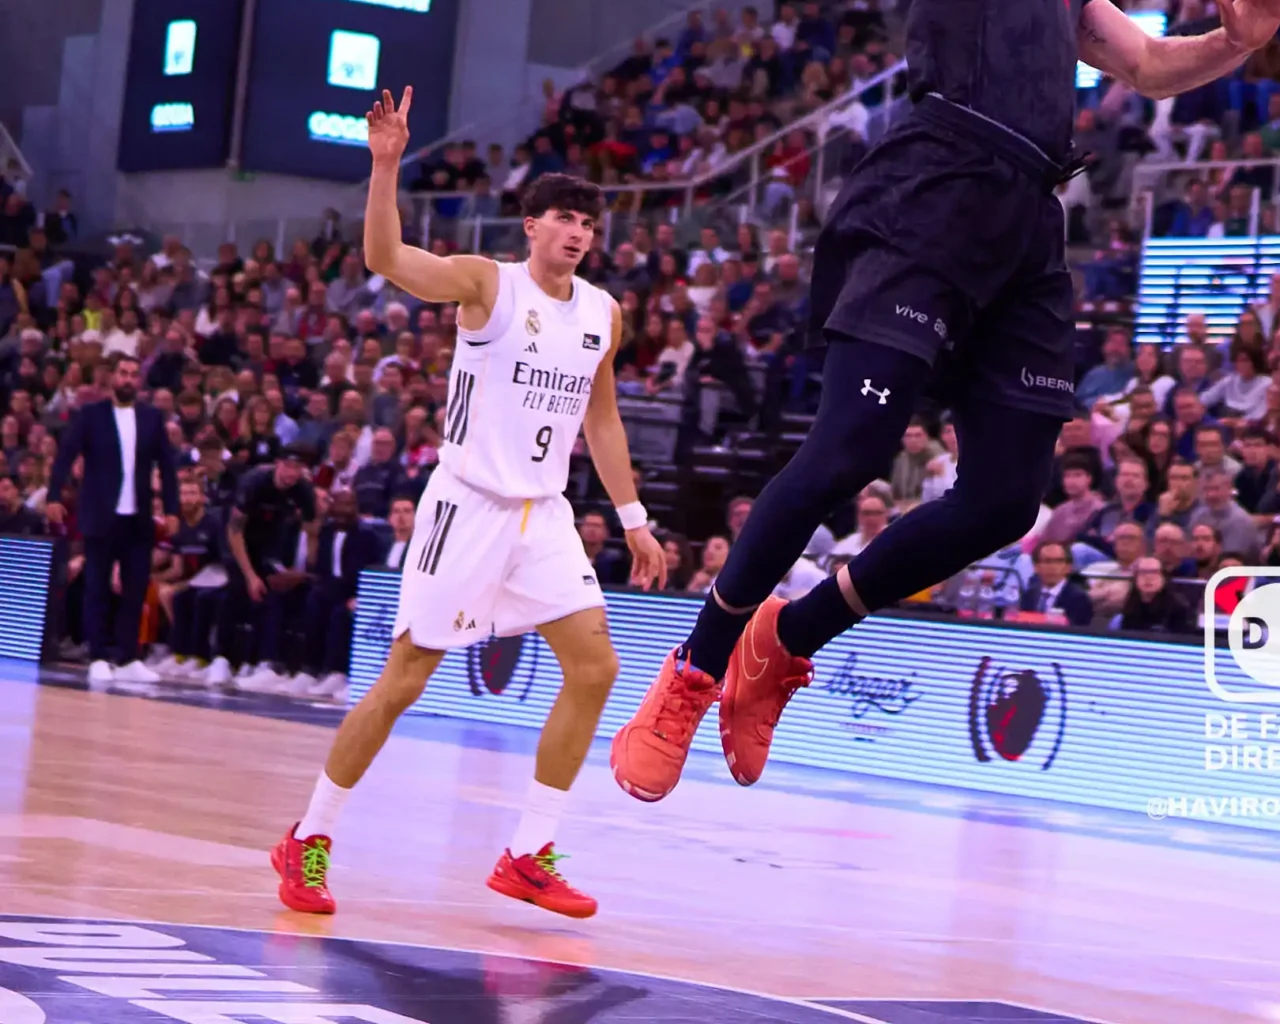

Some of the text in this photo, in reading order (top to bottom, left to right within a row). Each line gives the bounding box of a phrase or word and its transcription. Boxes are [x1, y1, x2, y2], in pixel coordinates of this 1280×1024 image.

[895, 304, 929, 324] vive
[522, 390, 546, 411] FLY
[531, 426, 553, 463] 9
